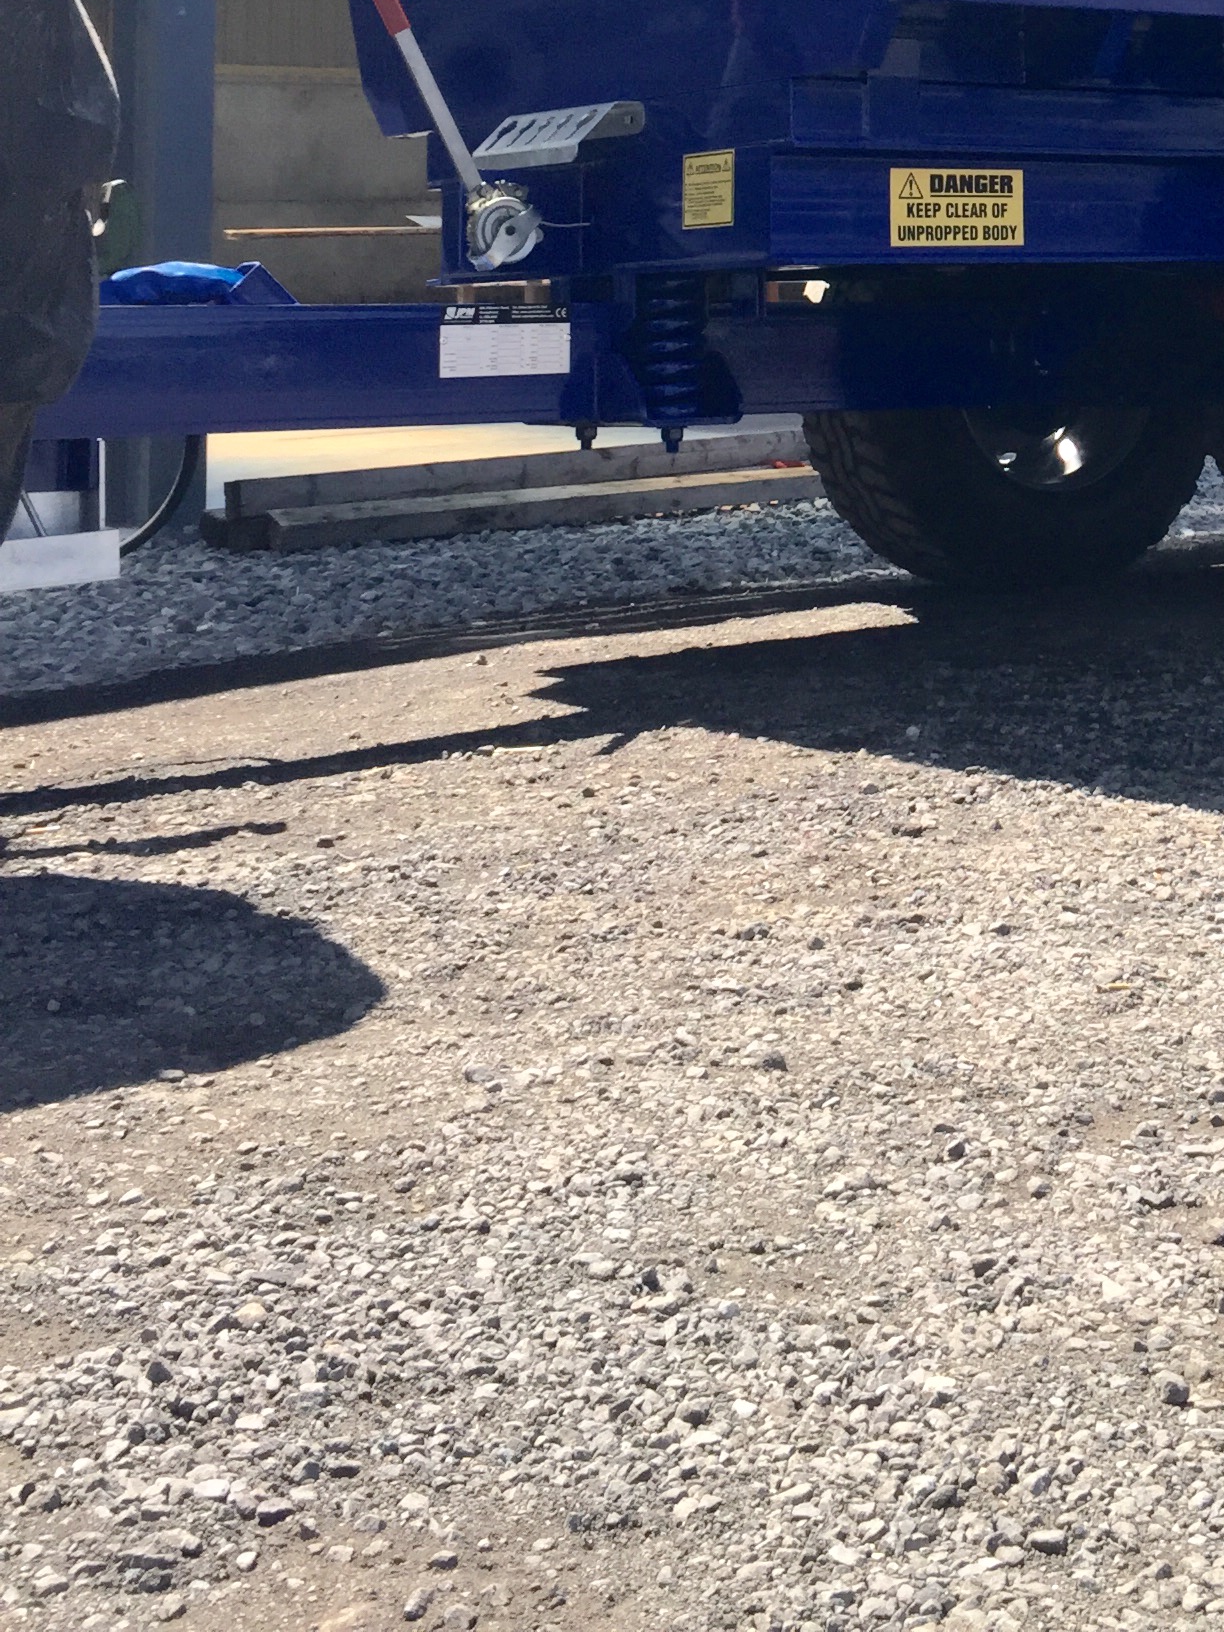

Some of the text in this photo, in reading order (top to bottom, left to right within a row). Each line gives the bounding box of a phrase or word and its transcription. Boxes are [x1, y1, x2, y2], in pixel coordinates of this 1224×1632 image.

[930, 174, 1013, 193] DANGER
[907, 203, 1008, 218] KEEP CLEAR OF
[898, 225, 1017, 241] UNPROPPED BODY
